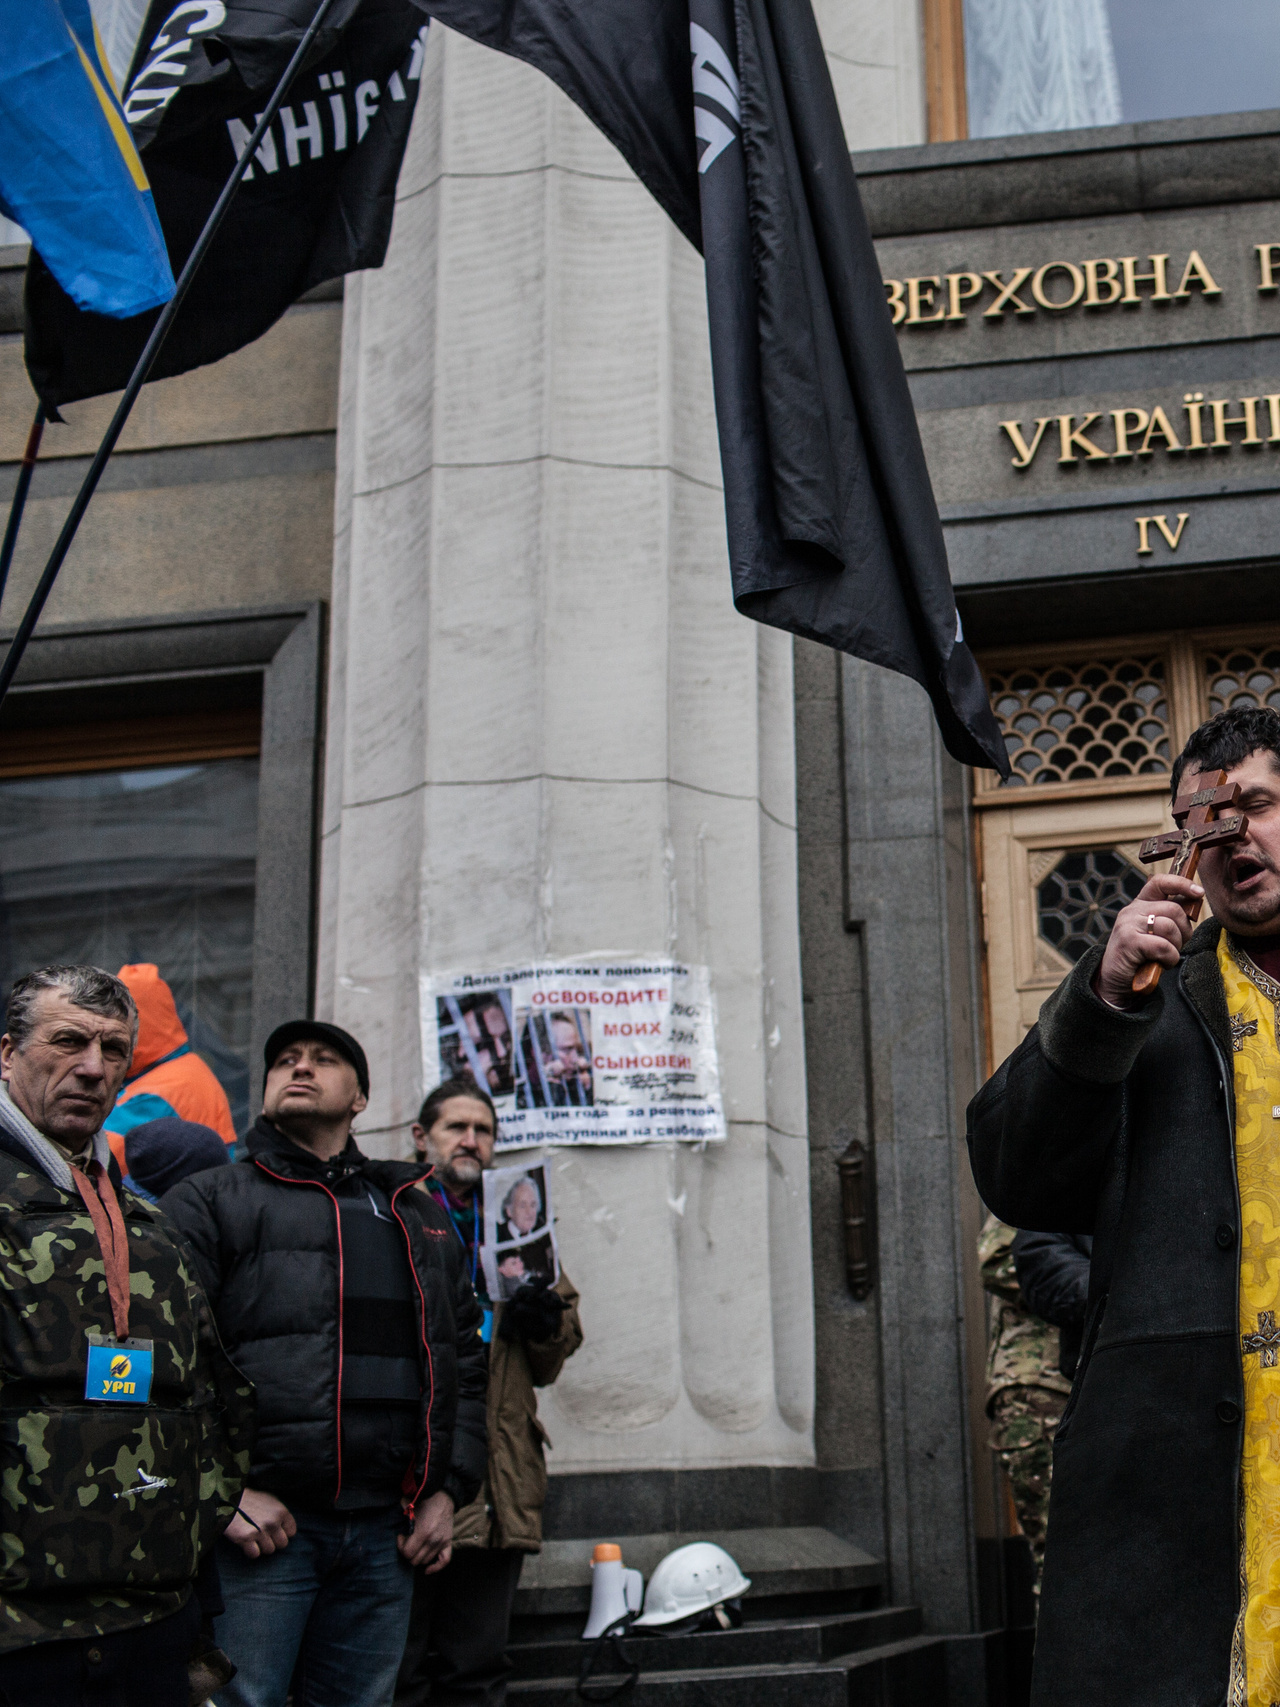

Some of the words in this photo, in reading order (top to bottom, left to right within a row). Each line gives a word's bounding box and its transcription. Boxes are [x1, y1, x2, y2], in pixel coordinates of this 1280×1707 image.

[1135, 513, 1189, 554] IV
[532, 988, 668, 1005] ОСВОБОДИТЕ
[604, 1022, 662, 1036] МОИХ
[102, 1380, 136, 1395] УРП
